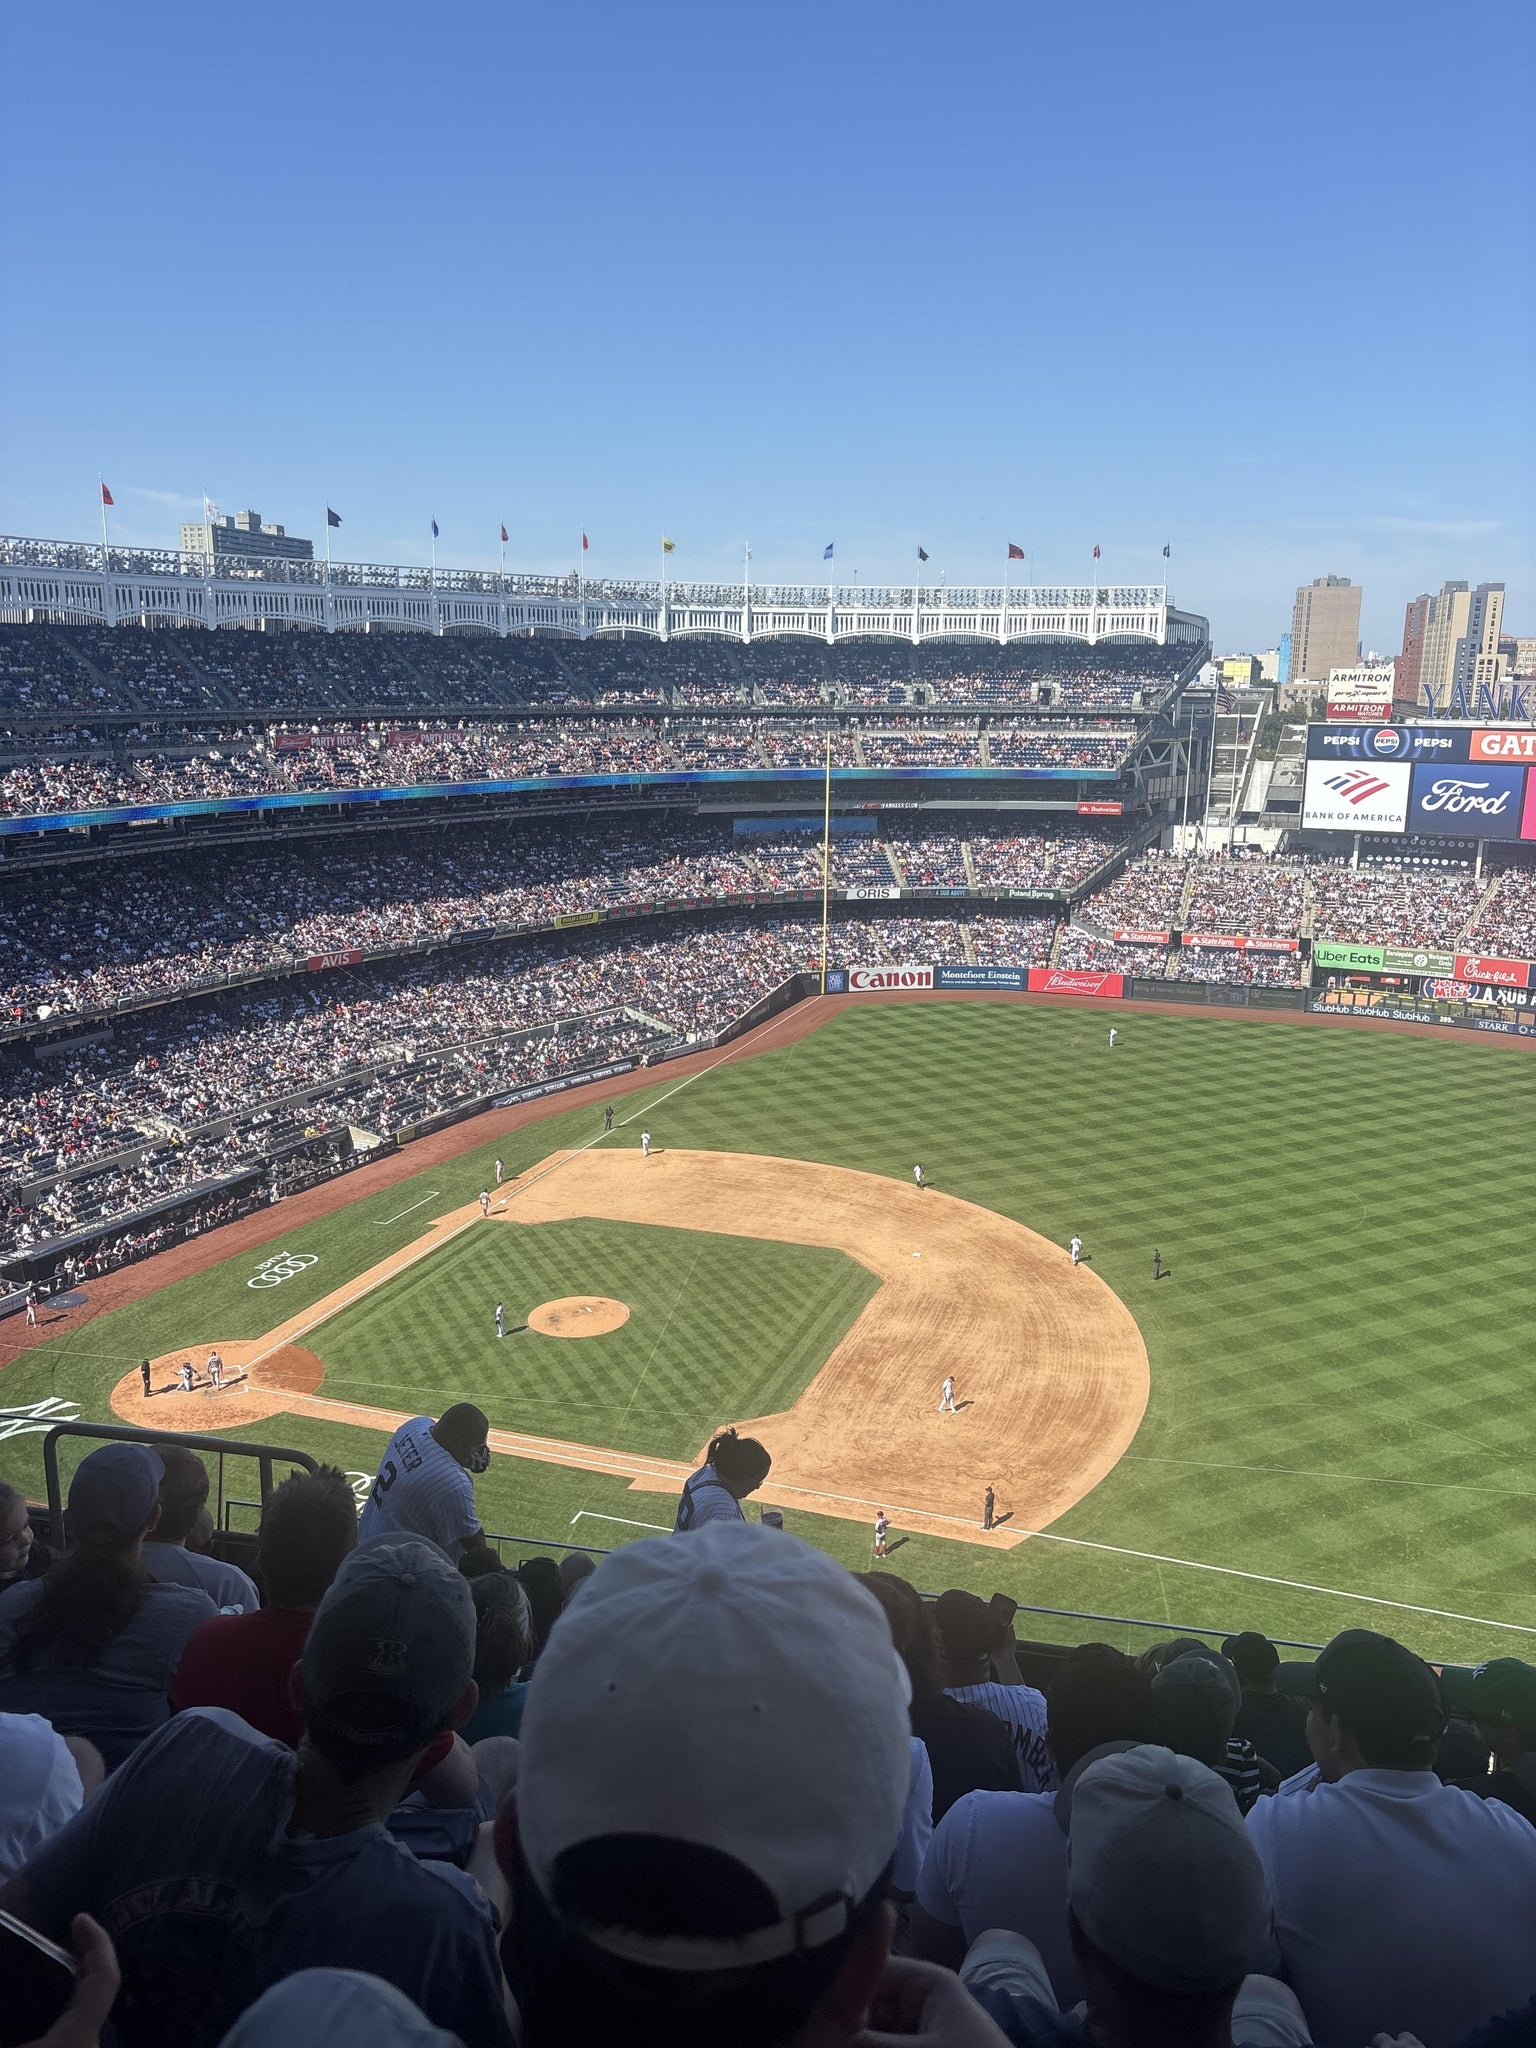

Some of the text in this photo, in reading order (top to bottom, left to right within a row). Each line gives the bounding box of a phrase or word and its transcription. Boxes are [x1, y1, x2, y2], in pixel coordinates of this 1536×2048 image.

[1332, 674, 1391, 682] ARMITRON
[1421, 682, 1535, 721] YANK
[1332, 704, 1385, 712] ARMITRON
[311, 736, 336, 747] PARTY
[337, 736, 358, 745] DECK
[421, 733, 442, 743] PARTY
[1323, 735, 1360, 746] PEPSI
[1414, 737, 1453, 748] PEPSI
[1480, 734, 1536, 756] GAT
[1421, 779, 1511, 815] Ford
[1305, 811, 1403, 822] BANK OF AMERICA
[856, 888, 890, 898] ORIS
[1032, 890, 1054, 899] Spring
[1130, 933, 1164, 942] State Farm
[1218, 938, 1235, 946] Farm
[1255, 940, 1290, 949] State Farm
[320, 953, 350, 968] AVIS
[1317, 950, 1348, 962] Uber
[1350, 952, 1380, 965] Eats
[850, 971, 931, 989] Canon
[941, 970, 1021, 980] Montefiore Einstein
[1051, 976, 1101, 989] Budweiser
[1483, 986, 1493, 1001] A
[1497, 987, 1527, 1006] SUB
[1313, 1003, 1430, 1022] StubHub StubHub StubHub
[1478, 1021, 1508, 1031] STARR
[153, 1187, 196, 1205] Welcome
[394, 1433, 423, 1474] JETER
[373, 1461, 397, 1508] 2
